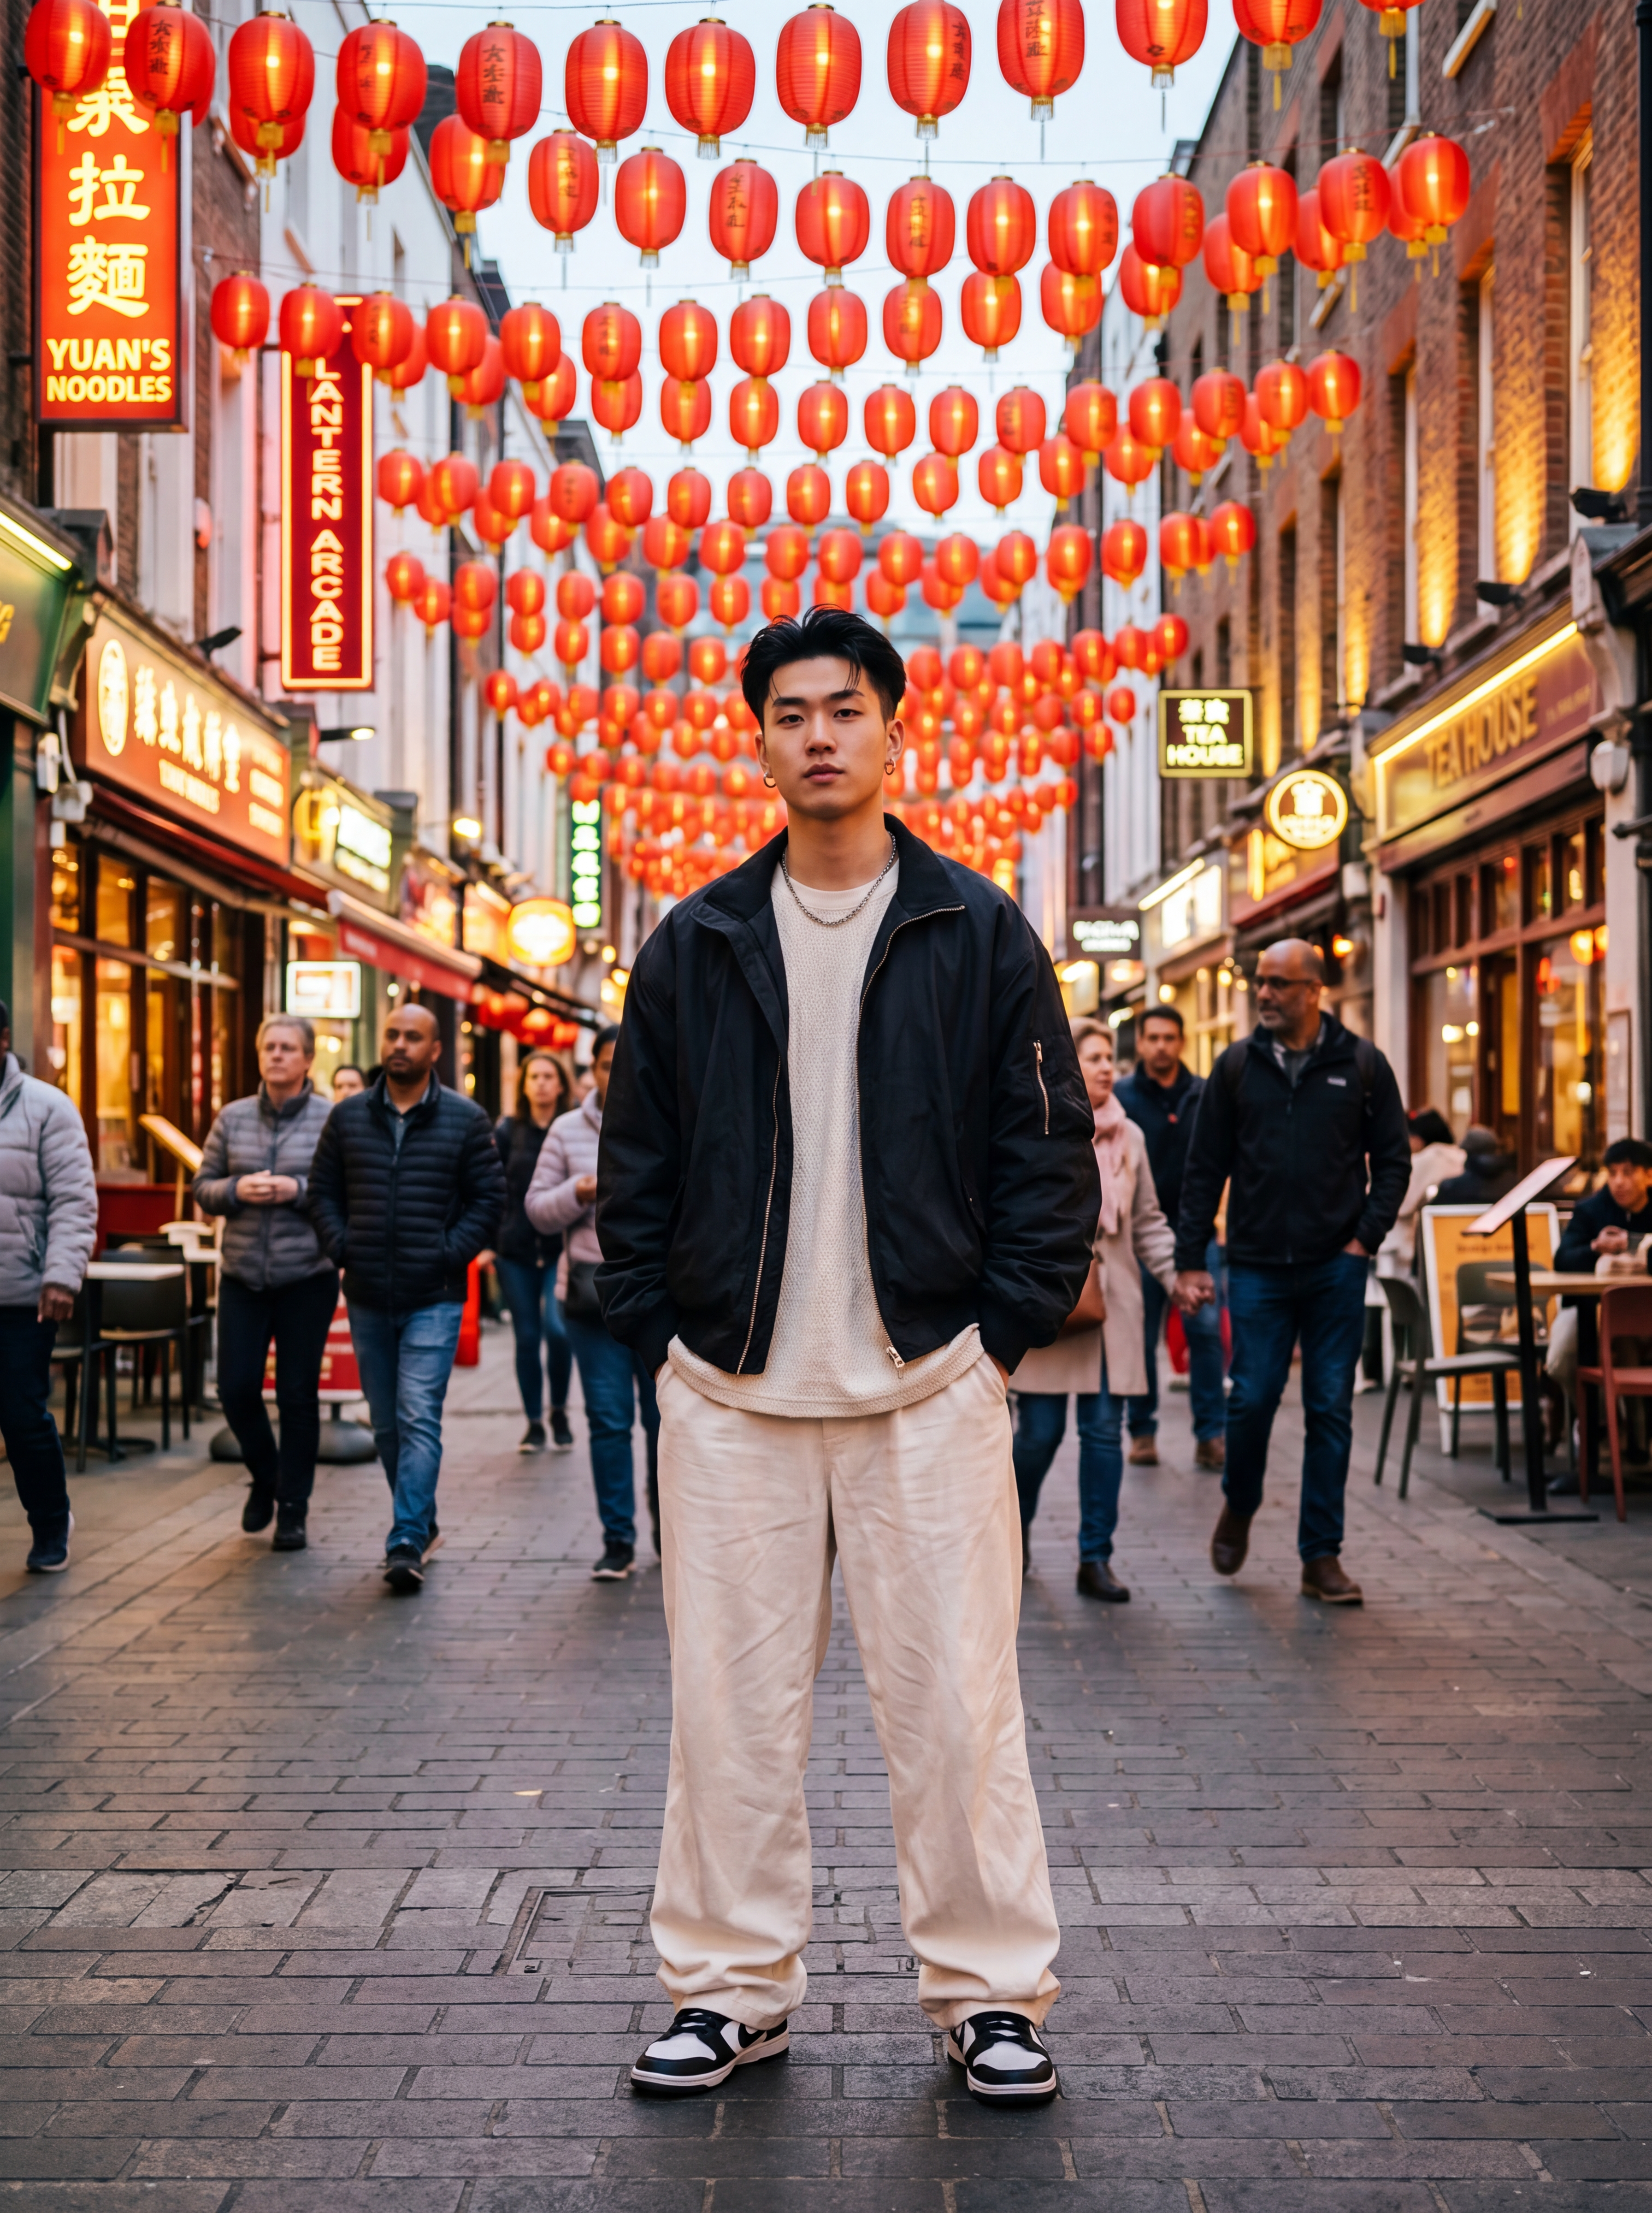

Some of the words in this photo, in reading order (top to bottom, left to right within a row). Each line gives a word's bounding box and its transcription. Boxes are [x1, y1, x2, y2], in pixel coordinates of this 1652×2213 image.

[46, 338, 171, 372] YUAN'S
[47, 375, 172, 402] NOODLES
[309, 357, 344, 520] LANTERN
[309, 529, 344, 671] ARCADE
[1181, 724, 1228, 745] TEA
[1464, 673, 1539, 775] HOUSE
[1167, 743, 1244, 767] HOUSE
